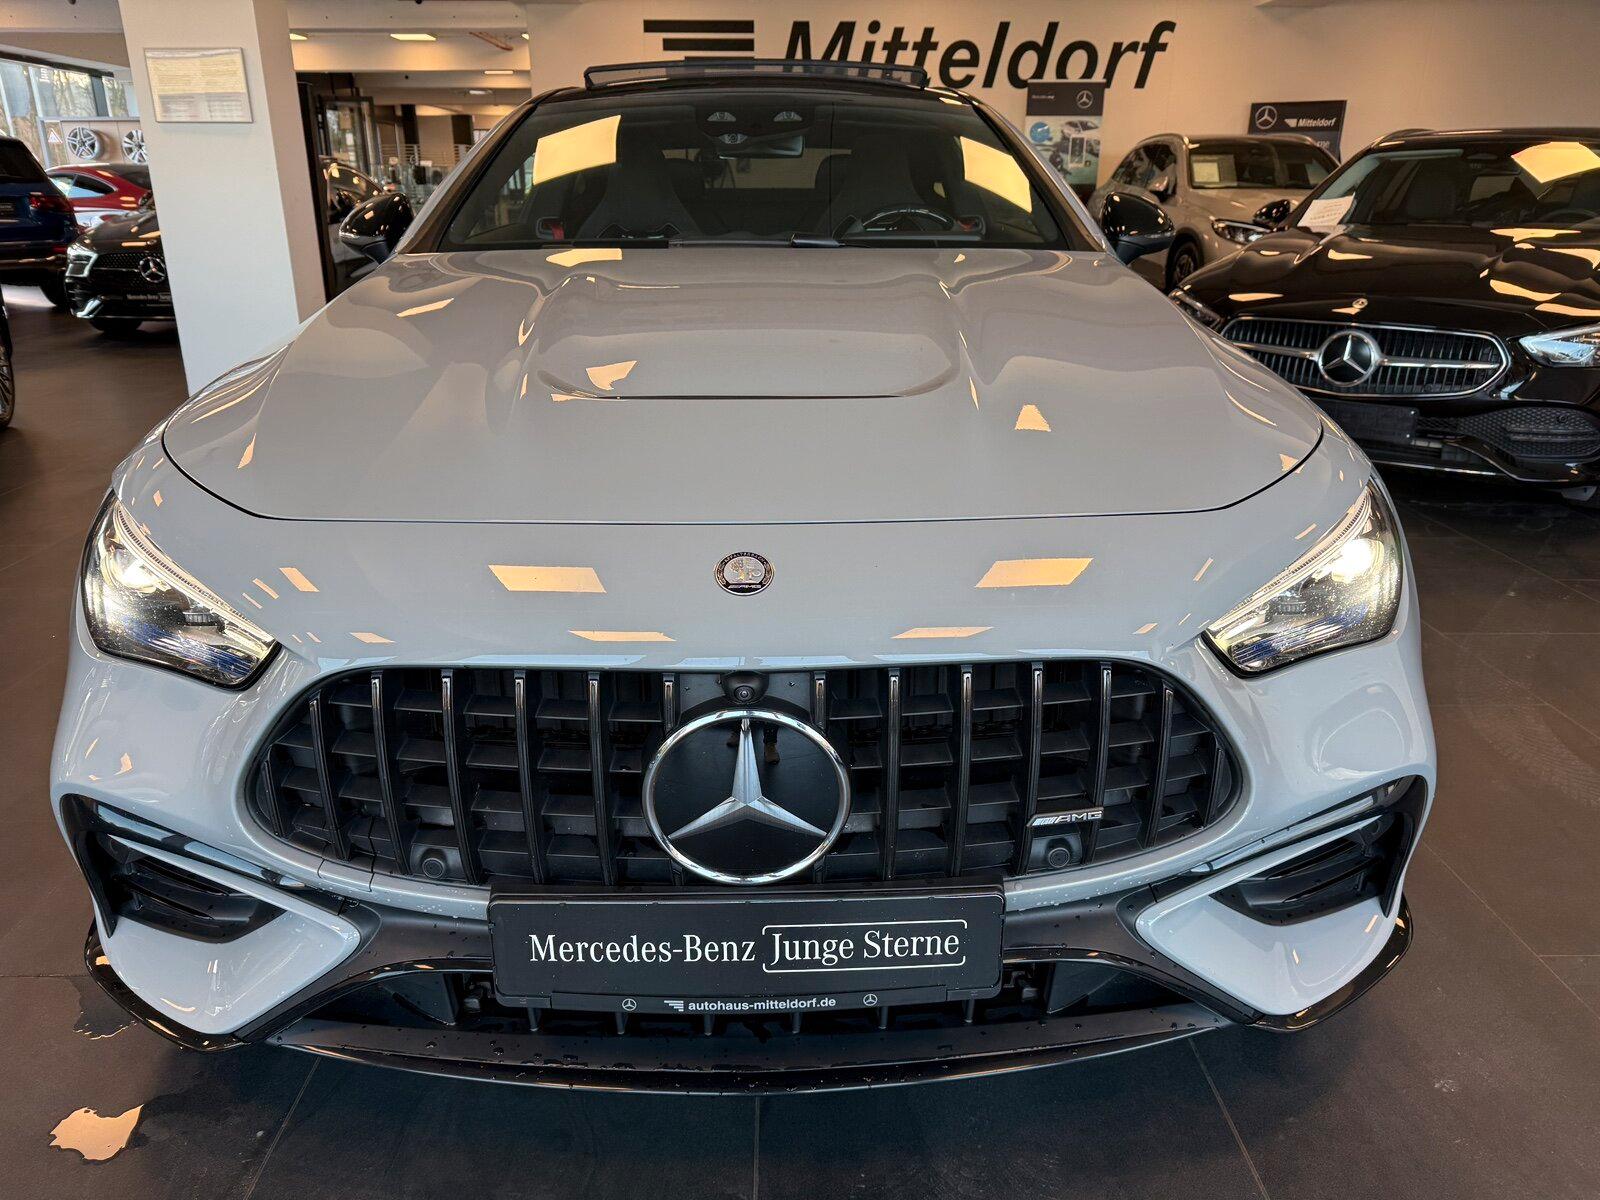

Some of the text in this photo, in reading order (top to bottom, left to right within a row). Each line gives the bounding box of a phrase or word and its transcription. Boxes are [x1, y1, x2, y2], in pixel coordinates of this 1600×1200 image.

[783, 20, 1177, 89] Mitteldorf
[1298, 118, 1336, 128] Mitteldorf
[1054, 810, 1103, 823] AMG
[528, 930, 960, 966] Mercedes-Benz Junge Sterne
[688, 997, 836, 1011] autohaus-mitteldorf.de
